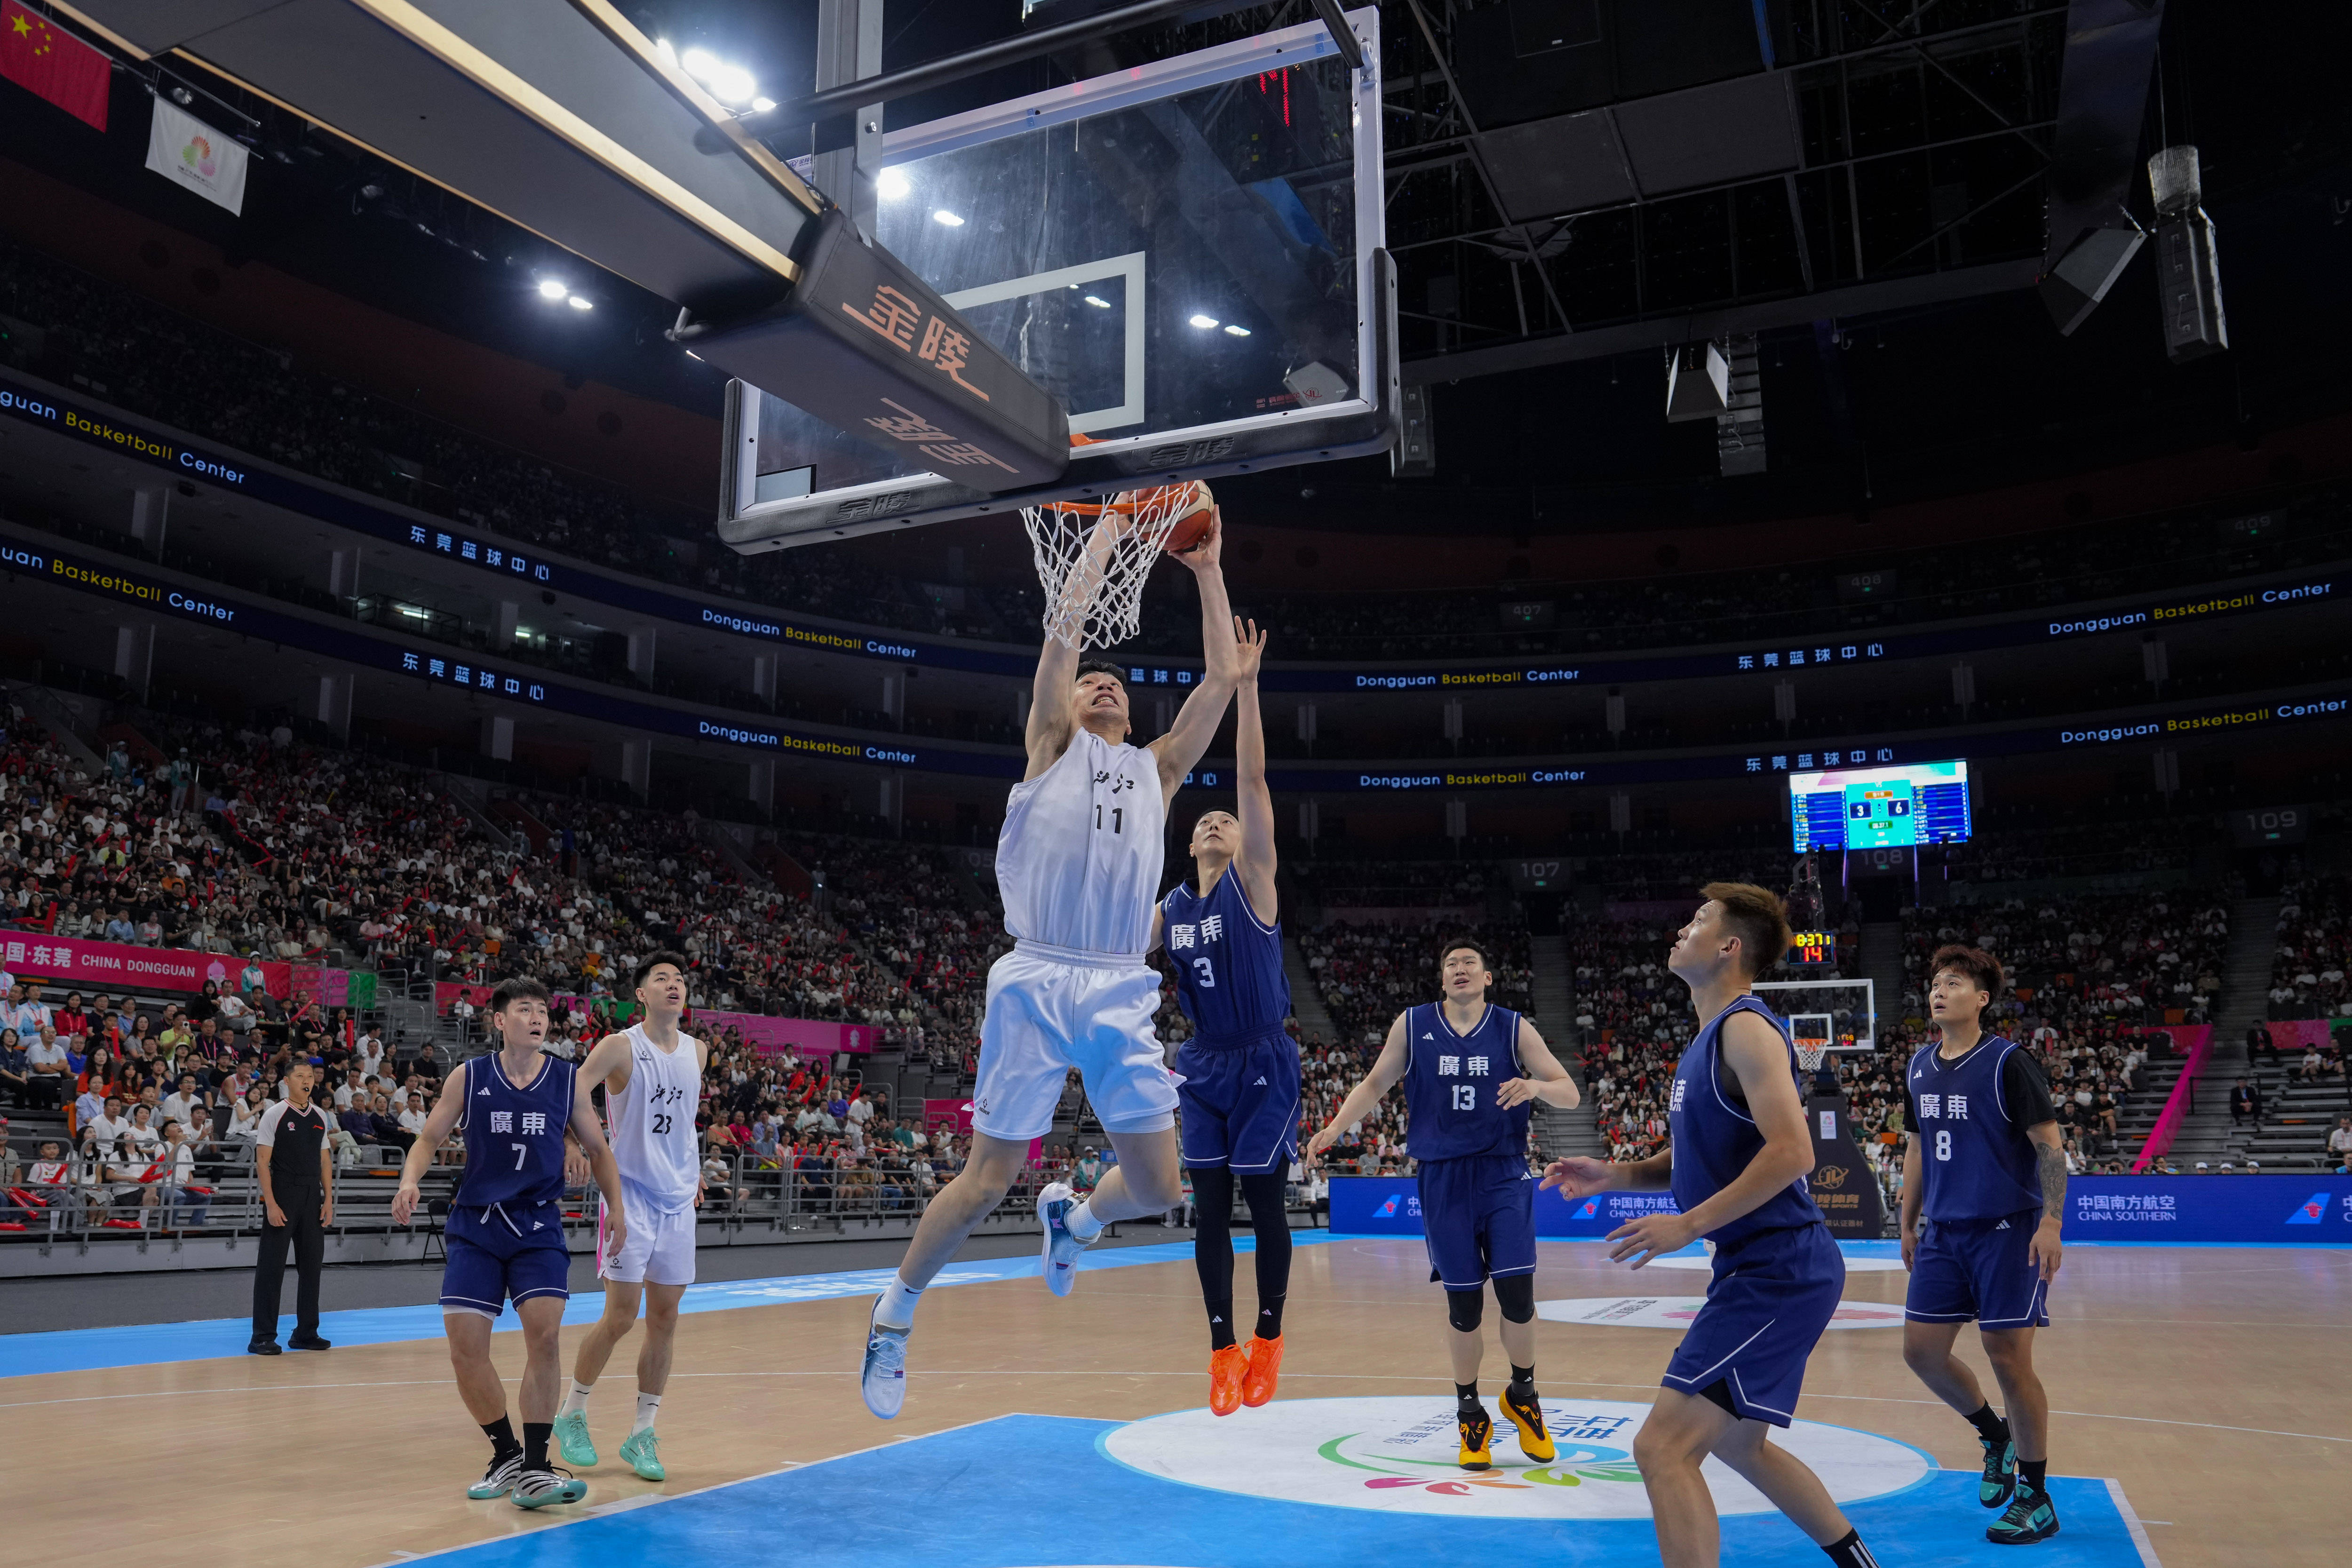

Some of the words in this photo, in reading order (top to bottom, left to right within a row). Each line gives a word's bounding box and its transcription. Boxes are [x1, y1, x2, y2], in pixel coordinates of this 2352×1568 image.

[842, 285, 989, 402] 金陵
[66, 412, 172, 460] Basketball
[180, 452, 245, 484] Center
[410, 525, 549, 580] 东莞篮球中心
[53, 559, 160, 601] Basketball
[169, 593, 234, 621] Center
[2050, 613, 2146, 635] Dongguan
[2154, 595, 2254, 620] Basketball
[2262, 583, 2330, 603] Center
[703, 609, 779, 635] Dongguan
[786, 627, 861, 649] Basketball
[866, 641, 916, 657] Center
[1738, 643, 1883, 669] 东莞篮球中心
[403, 653, 544, 700] 东莞篮球中心
[1357, 676, 1436, 688] Dongguan
[1442, 672, 1520, 684] Basketball
[1526, 669, 1579, 681] Center
[2061, 724, 2159, 743] Dongguan
[2167, 709, 2269, 731] Basketball
[2277, 700, 2347, 717] Center
[699, 721, 778, 745] Dongguan
[784, 736, 860, 756] Basketball
[866, 747, 916, 763] Center
[1745, 747, 1894, 772] 东莞篮球中心
[1360, 775, 1440, 788] Dongguan
[1447, 773, 1526, 784] Basketball
[1532, 771, 1585, 782] Center
[1096, 804, 1122, 834] 11
[1857, 805, 1864, 817] 3
[1896, 802, 1903, 813] 6
[2247, 810, 2297, 831] 109
[1521, 862, 1560, 877] 107
[1171, 914, 1223, 950] 廣東
[81, 954, 121, 970] CHINA
[127, 960, 196, 978] DONGGUAN
[1804, 946, 1822, 962] 14
[1193, 956, 1215, 987] 3
[1438, 1055, 1489, 1076] 廣東
[1452, 1085, 1476, 1111] 13
[1920, 1094, 1968, 1120] 廣東
[491, 1111, 546, 1135] 廣東
[652, 1114, 672, 1135] 23
[512, 1143, 527, 1170] 7
[1936, 1130, 1951, 1161] 8
[1609, 1196, 1678, 1209] 中国南方航空
[2078, 1195, 2176, 1210] 中国南方航空
[2078, 1211, 2113, 1221] CHINA
[2115, 1211, 2176, 1221] SOUTHERN
